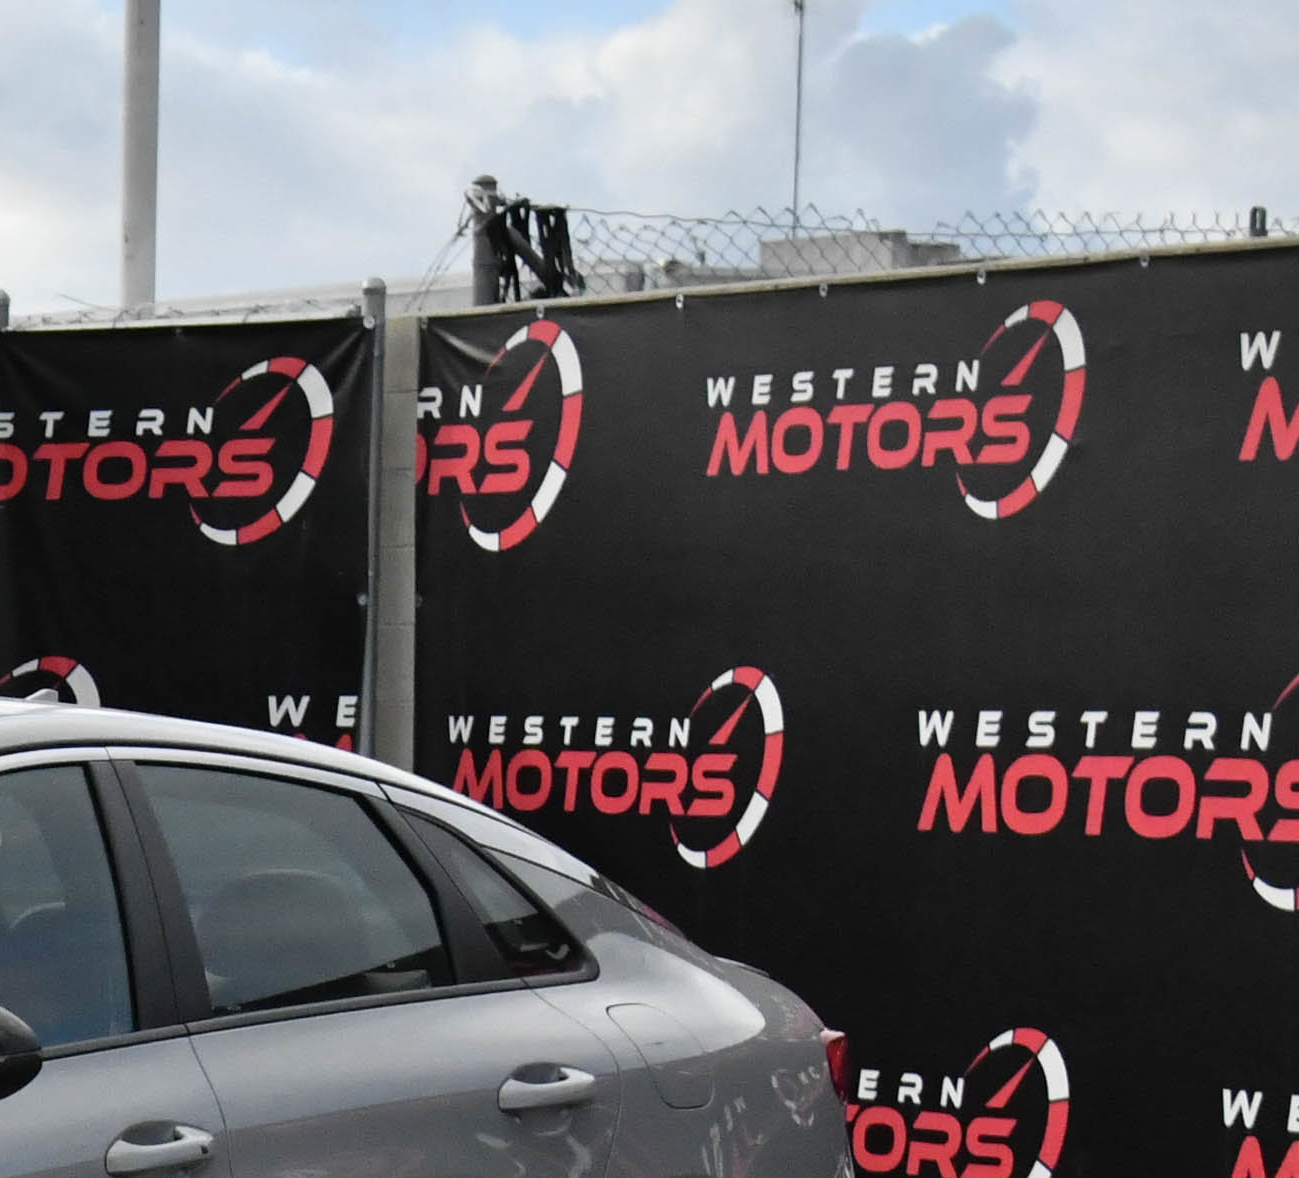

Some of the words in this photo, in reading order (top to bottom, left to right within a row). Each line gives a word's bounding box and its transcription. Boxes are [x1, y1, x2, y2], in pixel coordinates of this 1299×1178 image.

[706, 359, 981, 408] WESTERN
[706, 393, 1033, 477] MOTORS
[448, 715, 691, 748] WESTERN
[918, 709, 1273, 752] WESTERN
[452, 748, 739, 817] MOTORS
